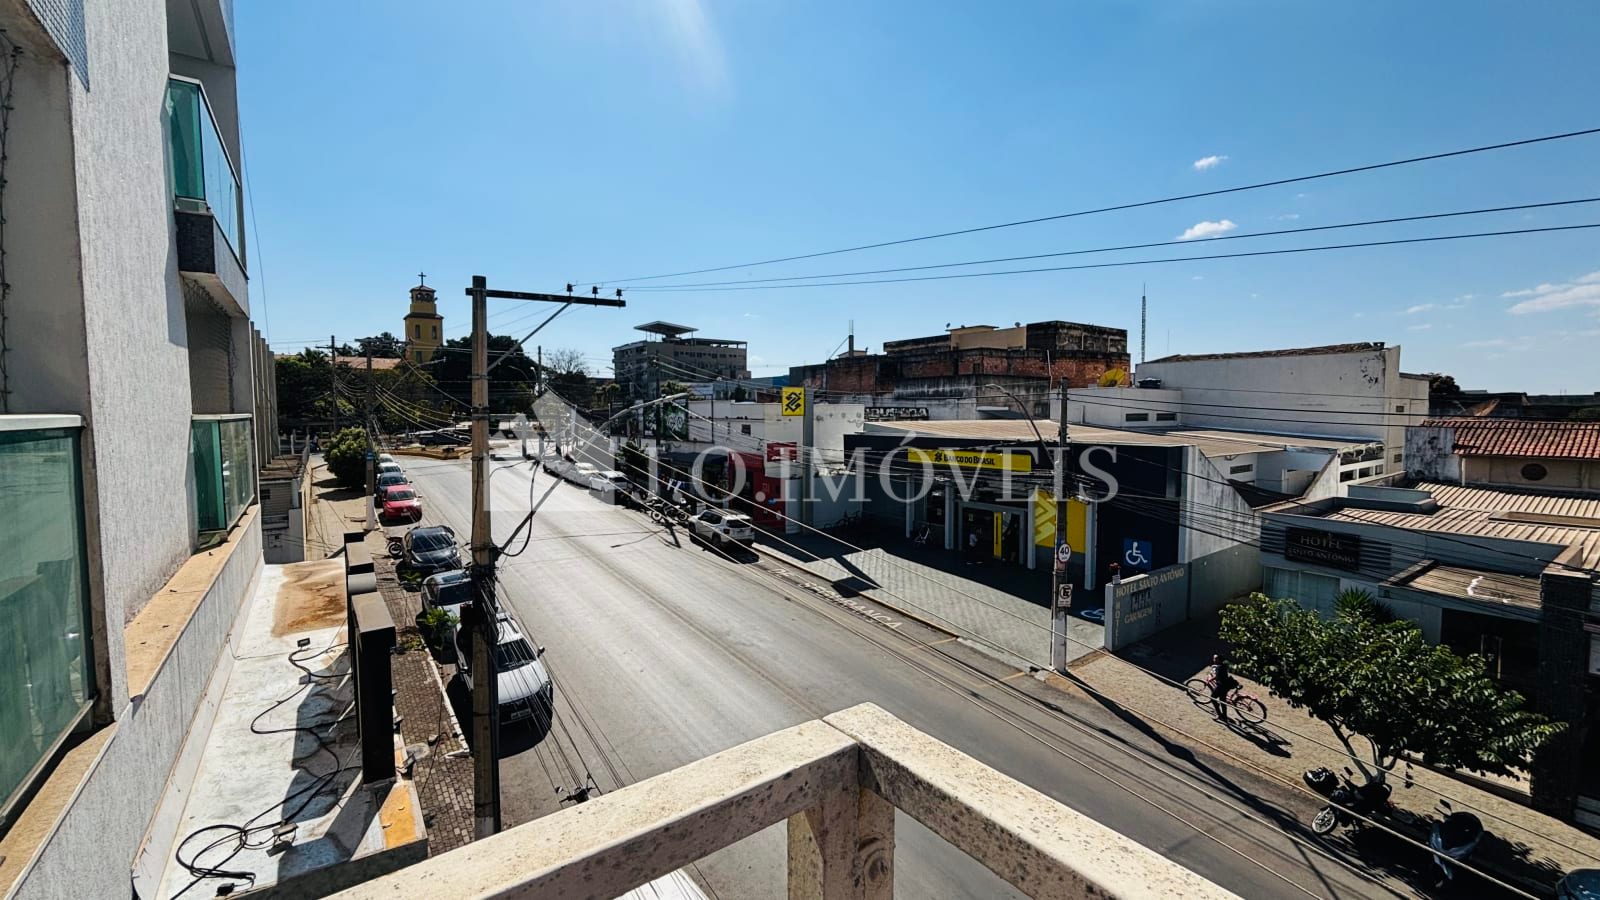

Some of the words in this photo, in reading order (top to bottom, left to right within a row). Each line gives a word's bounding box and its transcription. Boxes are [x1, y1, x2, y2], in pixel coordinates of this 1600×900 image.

[943, 455, 963, 464] BANCO
[964, 456, 973, 464] DO
[973, 456, 995, 466] BRASIL
[1300, 535, 1342, 550] HOTEL
[1060, 546, 1069, 555] 40
[1116, 582, 1137, 598] HOTEL
[1140, 575, 1159, 590] SANTO
[1124, 605, 1153, 624] GARAGEM
